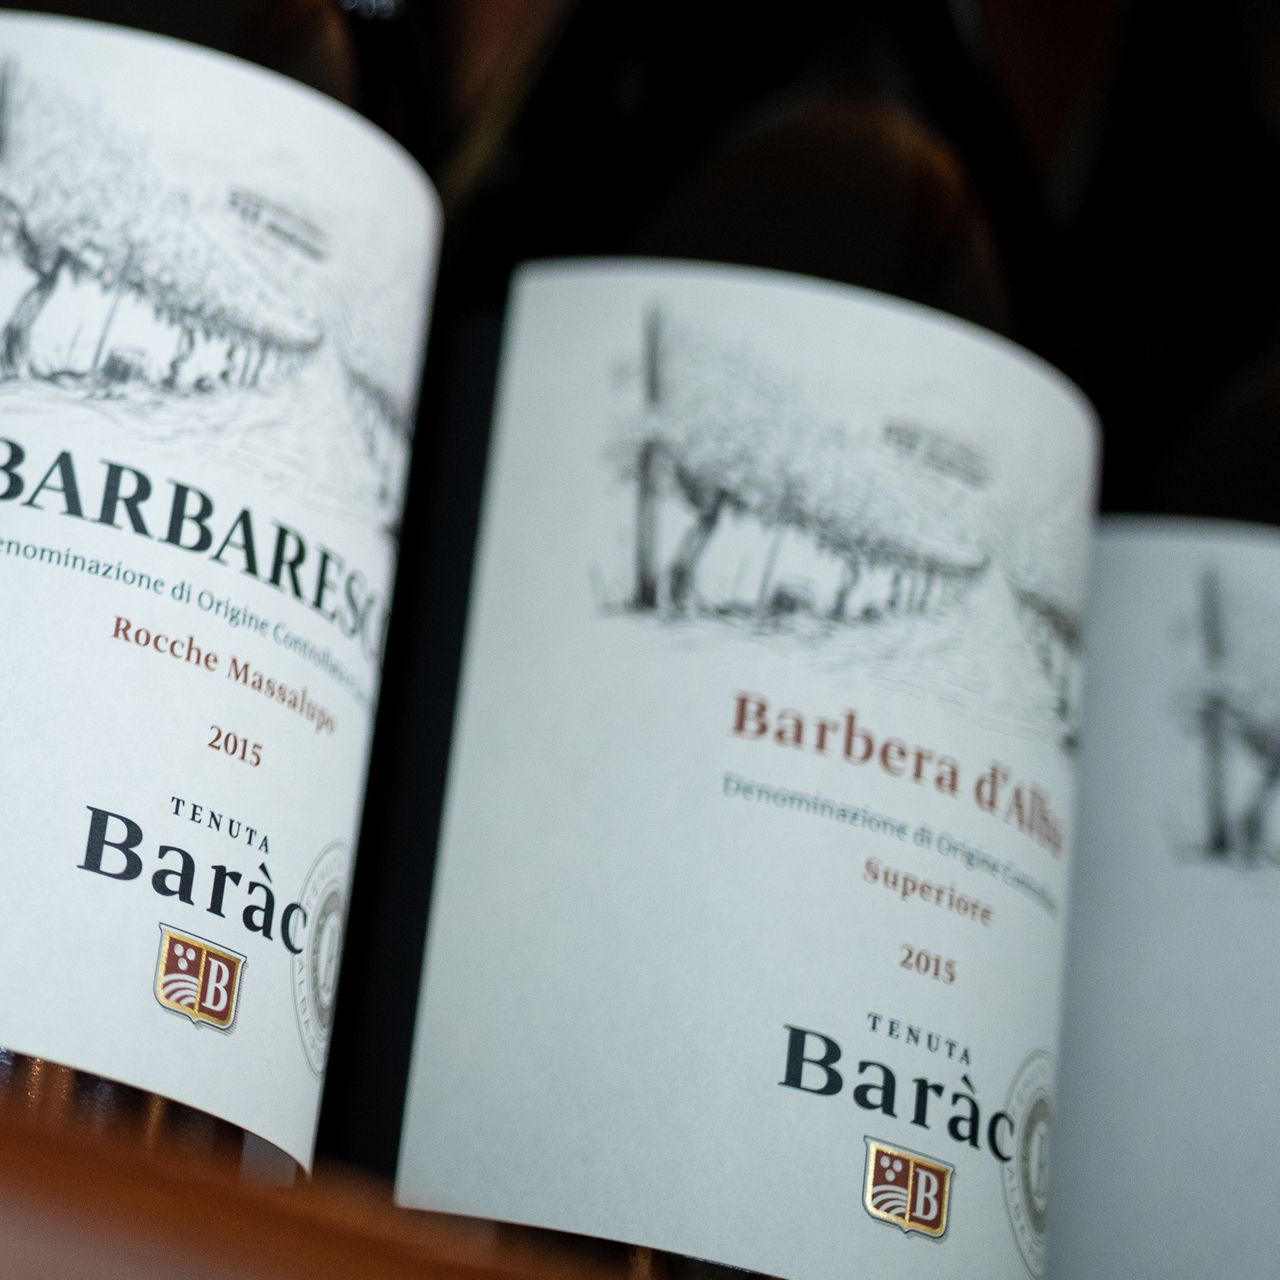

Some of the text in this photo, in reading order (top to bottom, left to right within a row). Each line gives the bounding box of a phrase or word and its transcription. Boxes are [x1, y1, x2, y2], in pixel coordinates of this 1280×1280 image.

[171, 581, 191, 604] di
[197, 590, 268, 638] Origine
[111, 615, 218, 671] Rocche
[227, 655, 336, 736] Massalupo
[207, 725, 264, 768] 2015
[733, 689, 959, 798] Barbera
[170, 796, 271, 854] TENUTA
[723, 771, 909, 841] Denominazione
[76, 805, 307, 954] Baràc
[863, 856, 993, 927] Superiore
[201, 956, 230, 1013] B
[899, 944, 957, 985] 2015
[867, 1013, 973, 1067] TENUTA
[778, 1024, 1015, 1163] Baràc
[913, 1167, 939, 1222] B
